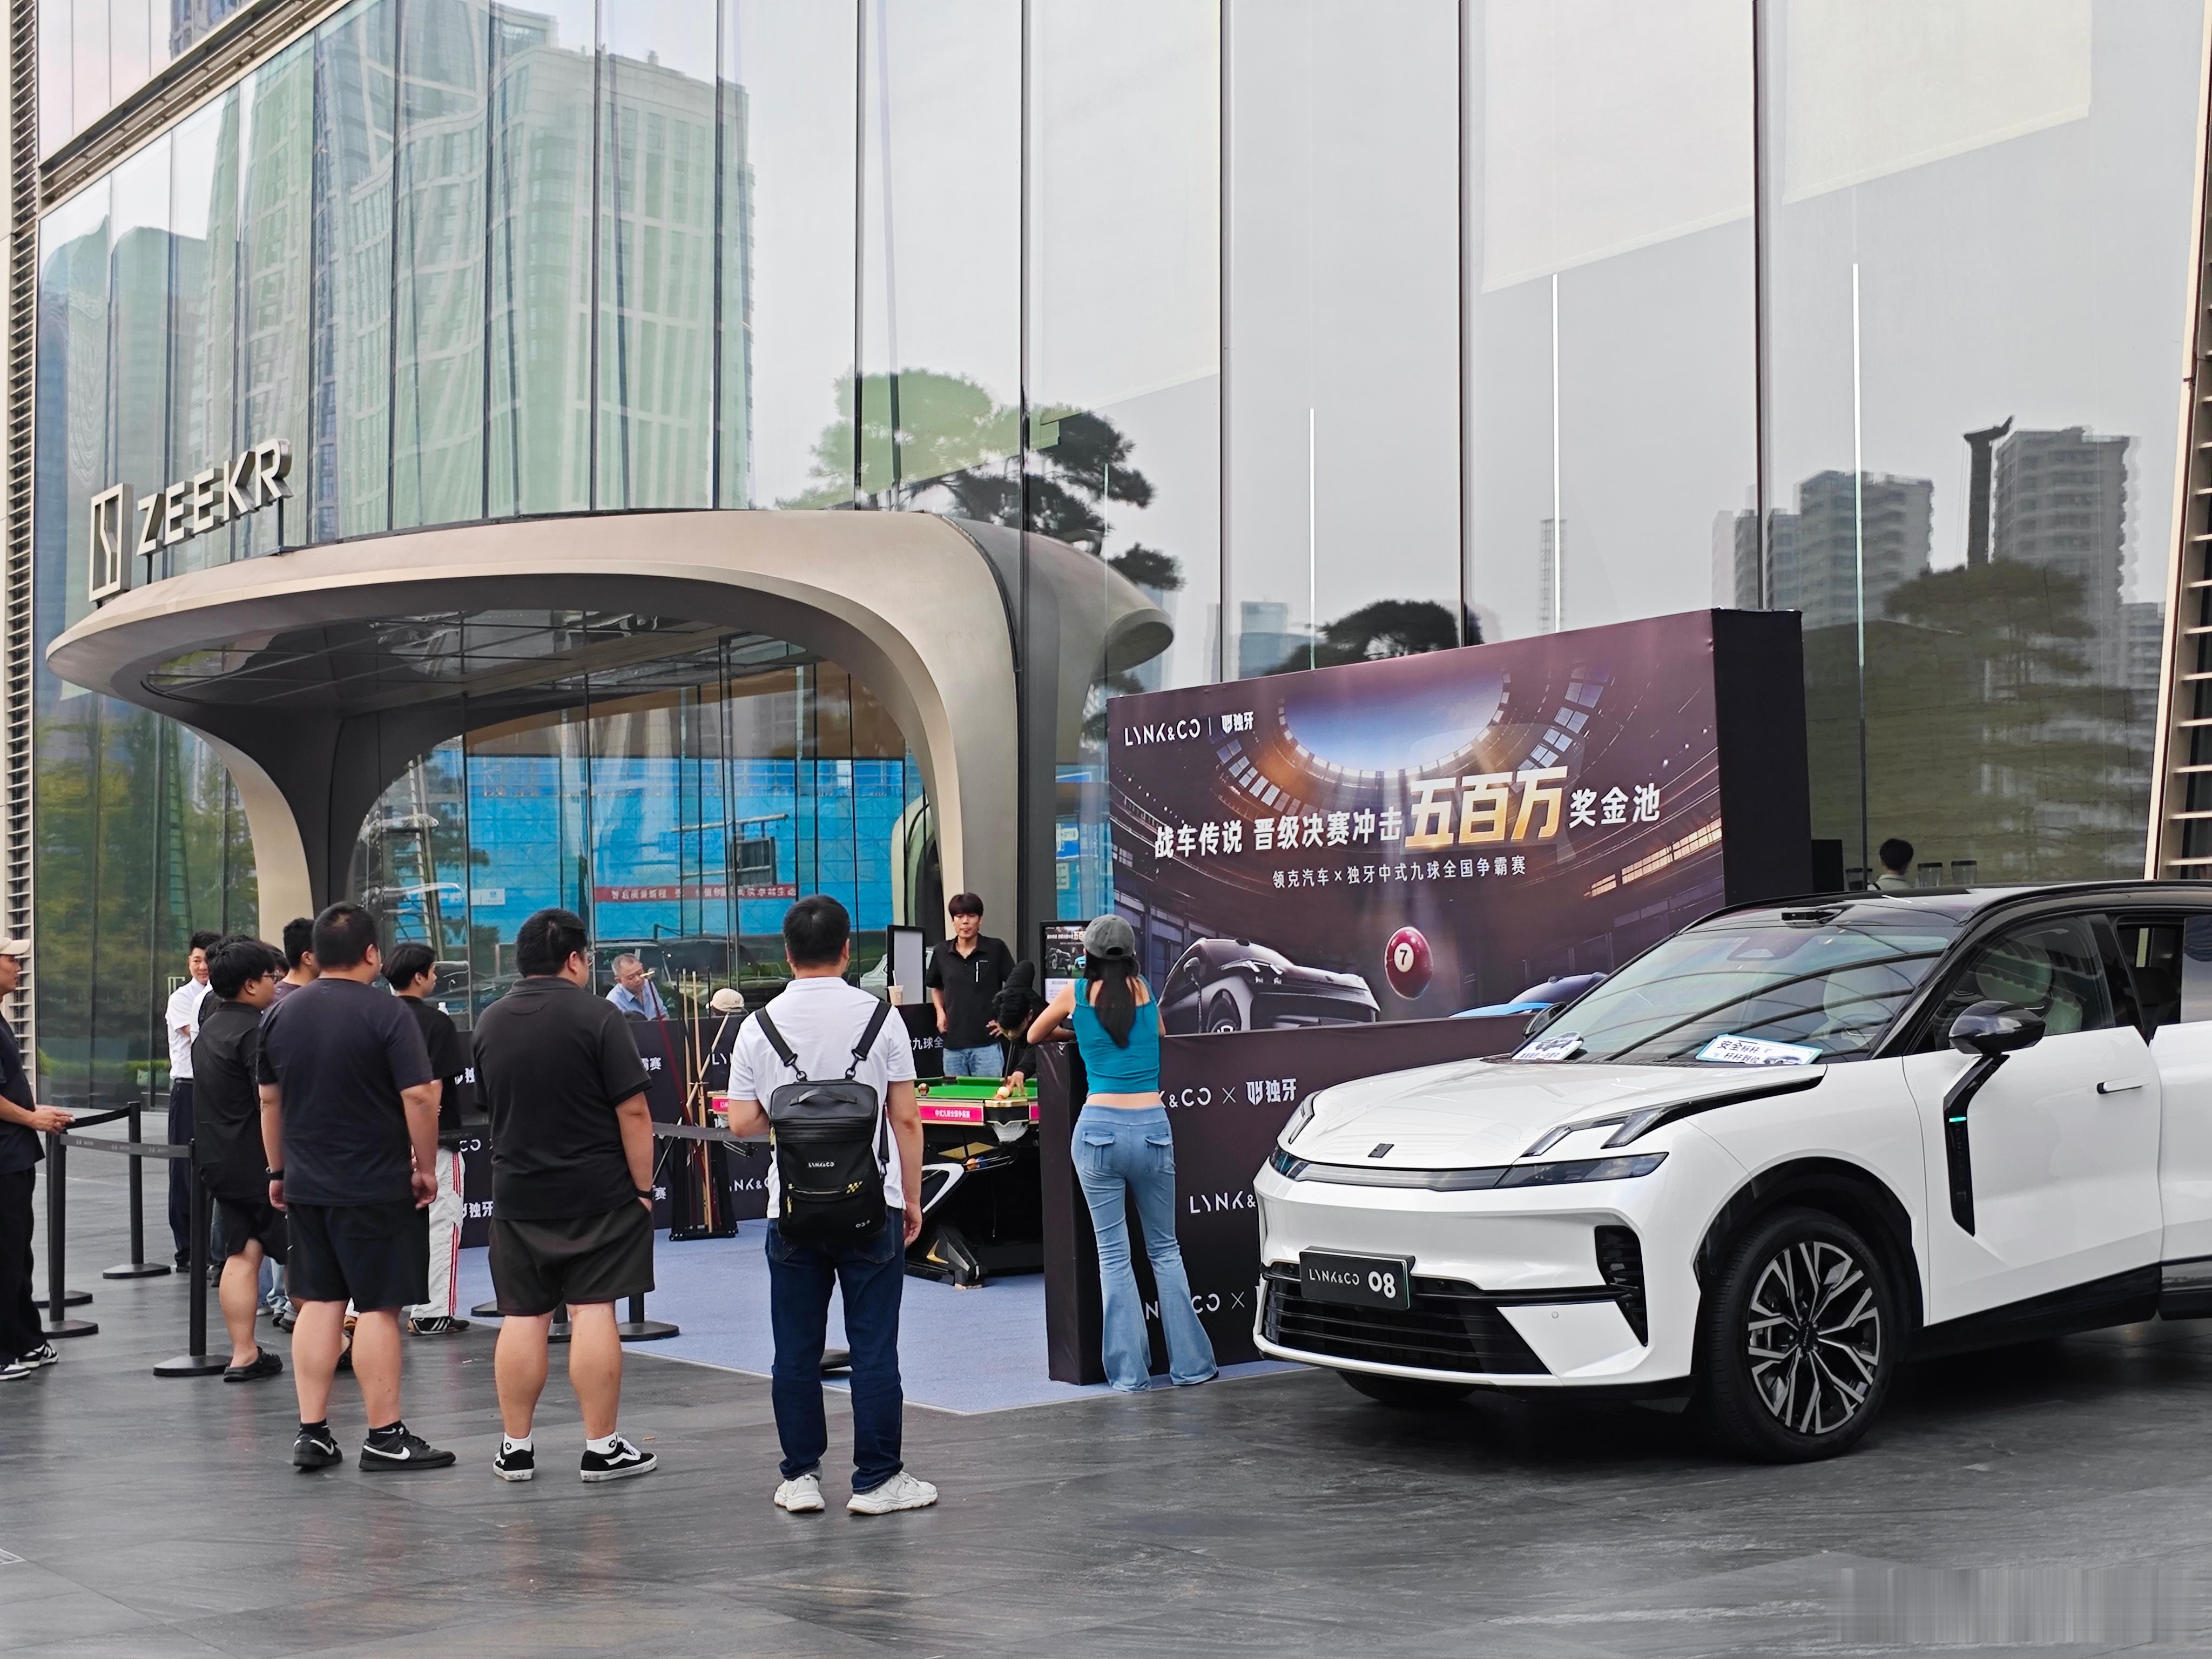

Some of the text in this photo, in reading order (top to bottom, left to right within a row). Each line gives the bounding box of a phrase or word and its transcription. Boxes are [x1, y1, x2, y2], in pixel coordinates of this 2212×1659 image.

[136, 438, 292, 556] ZEEKR
[1124, 718, 1201, 746] LYNK&CO
[1155, 766, 1661, 859] 战车传说 晋级决赛冲击 五百万 奖金池
[1399, 949, 1407, 966] 7
[1309, 1269, 1397, 1299] LYNK&CO 08
